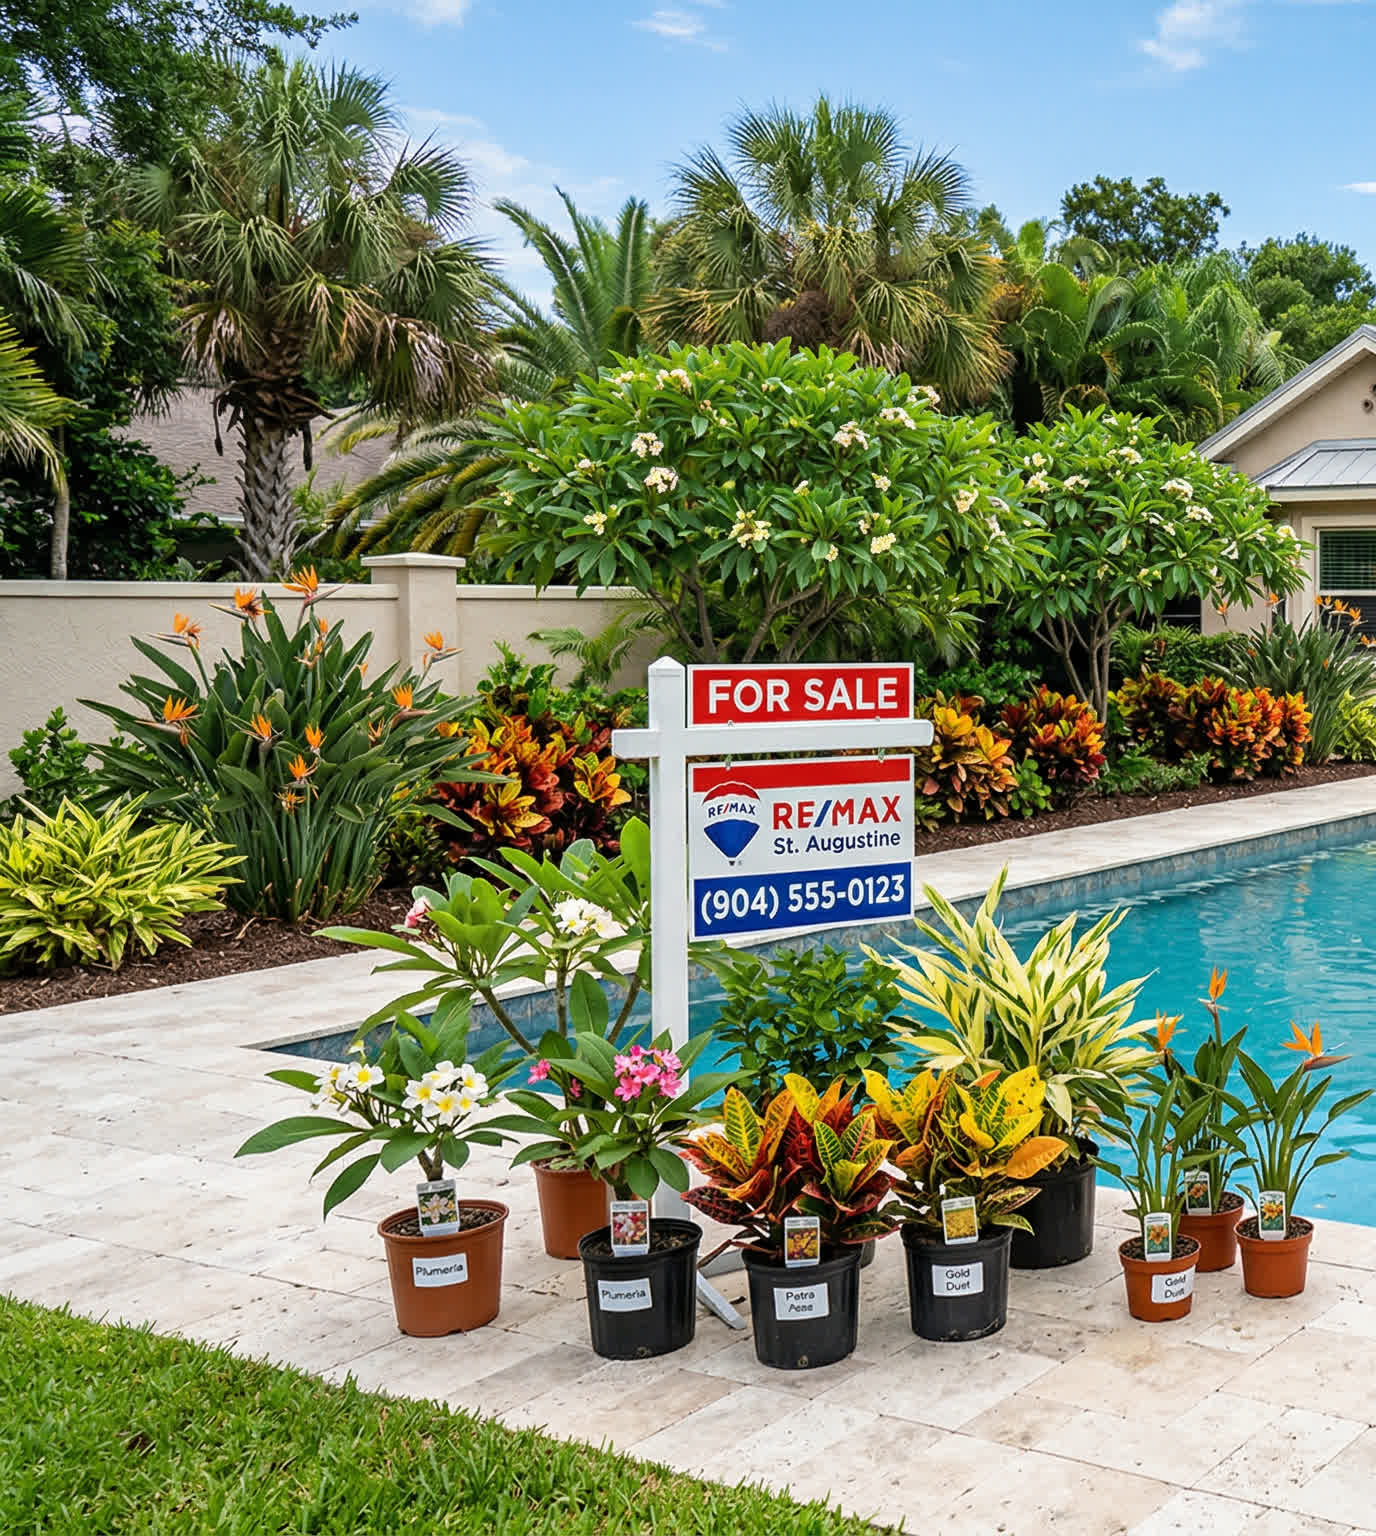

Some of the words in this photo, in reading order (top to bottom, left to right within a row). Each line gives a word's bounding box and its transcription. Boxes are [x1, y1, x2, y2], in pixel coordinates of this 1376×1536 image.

[708, 678, 790, 714] FOR
[804, 677, 898, 711] SALE
[708, 802, 756, 818] RE/MAX
[772, 795, 901, 830] RE/MAX
[774, 837, 799, 855] St.
[805, 830, 901, 854] Augustine
[701, 885, 779, 925] (904)
[788, 874, 905, 913] 555-0123
[415, 1263, 464, 1276] Plumeria
[945, 1268, 970, 1279] Gold
[601, 1289, 646, 1300] Plumeria
